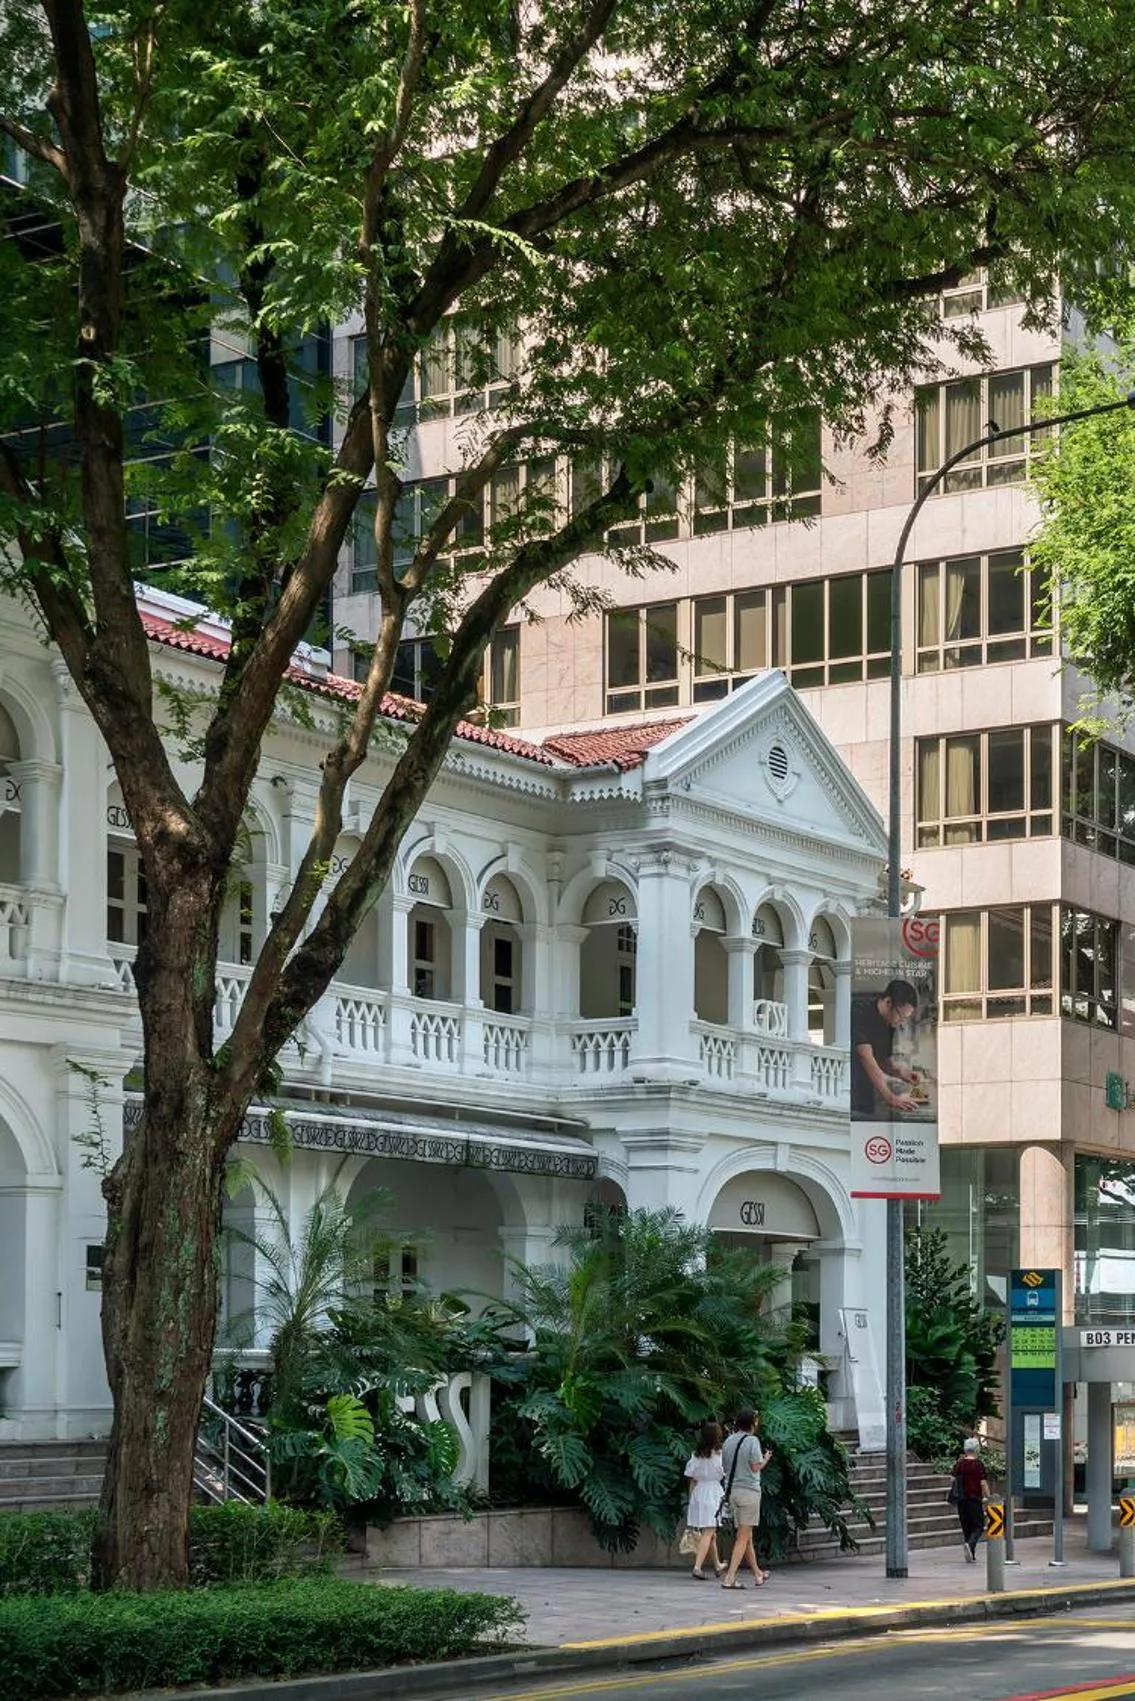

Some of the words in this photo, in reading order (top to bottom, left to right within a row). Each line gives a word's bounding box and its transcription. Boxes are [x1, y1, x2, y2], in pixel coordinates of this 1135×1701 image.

[408, 874, 429, 895] GESSI
[910, 921, 939, 942] SG
[905, 969, 928, 977] STAR
[869, 1144, 888, 1156] SG
[740, 1201, 764, 1226] GESSI
